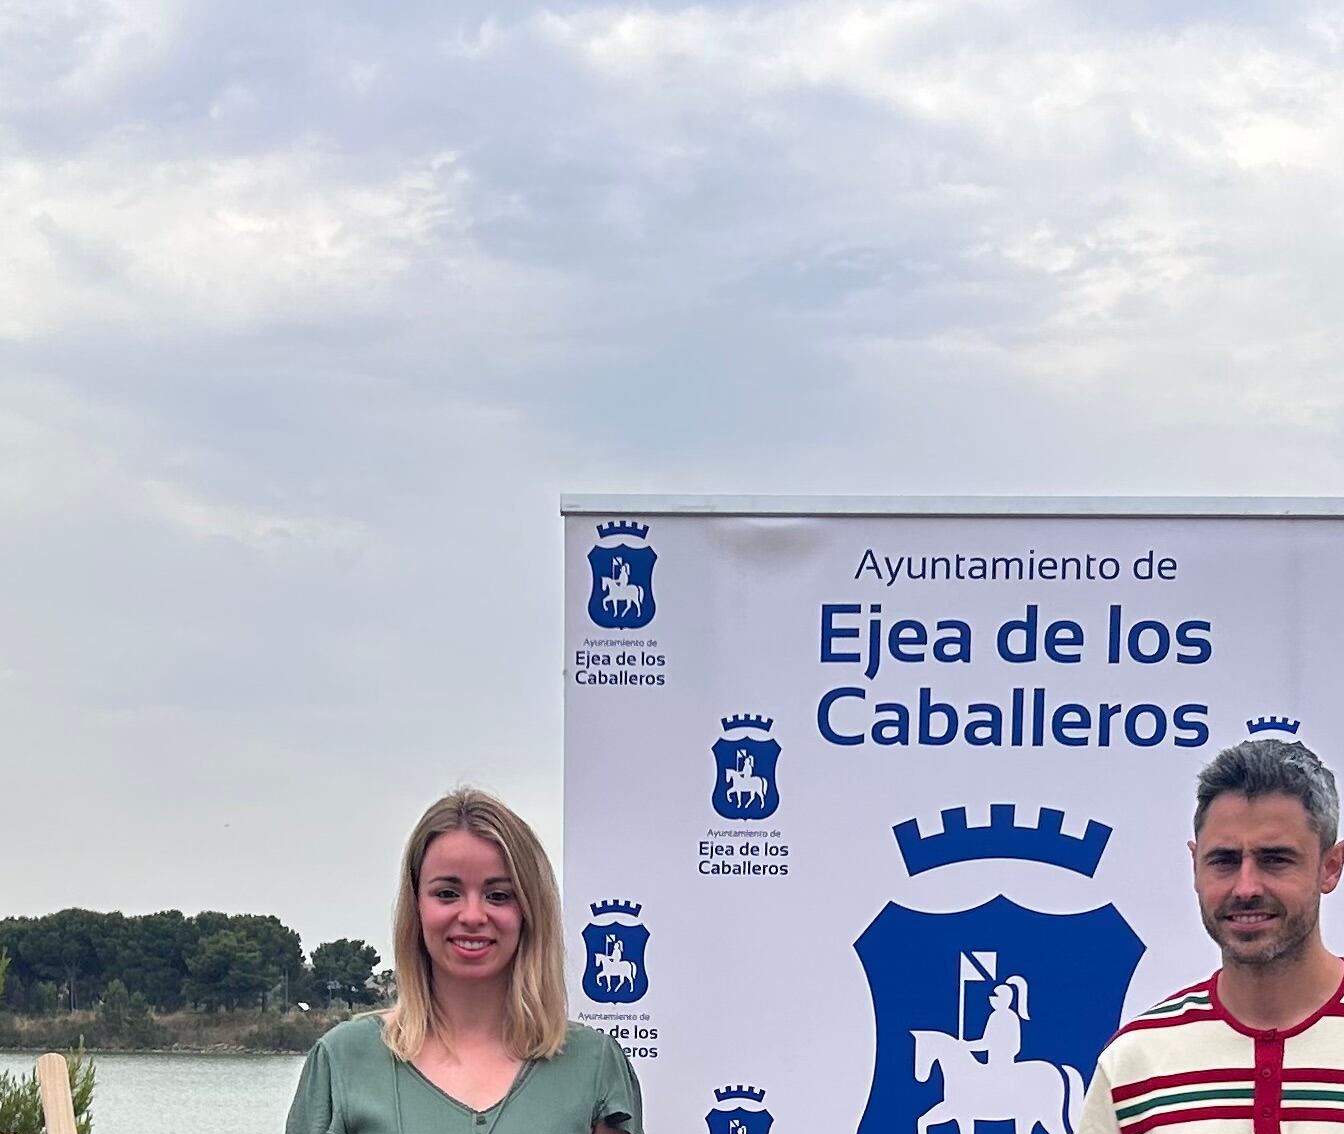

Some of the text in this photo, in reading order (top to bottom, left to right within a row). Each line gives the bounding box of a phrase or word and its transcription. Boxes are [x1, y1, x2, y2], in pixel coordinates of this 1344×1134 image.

[855, 550, 1176, 586] Ayuntamiento de
[584, 638, 644, 648] Ayuntamiento
[821, 604, 1212, 680] Ejea de los
[576, 651, 665, 669] Ejea de los
[576, 670, 664, 685] Caballeros
[818, 687, 1209, 747] Caballeros
[707, 829, 780, 838] Ayuntamiento de
[700, 842, 788, 859] Ejea de los
[699, 861, 788, 875] Caballeros
[640, 1012, 650, 1020] de
[609, 1025, 630, 1039] de
[634, 1026, 658, 1039] los
